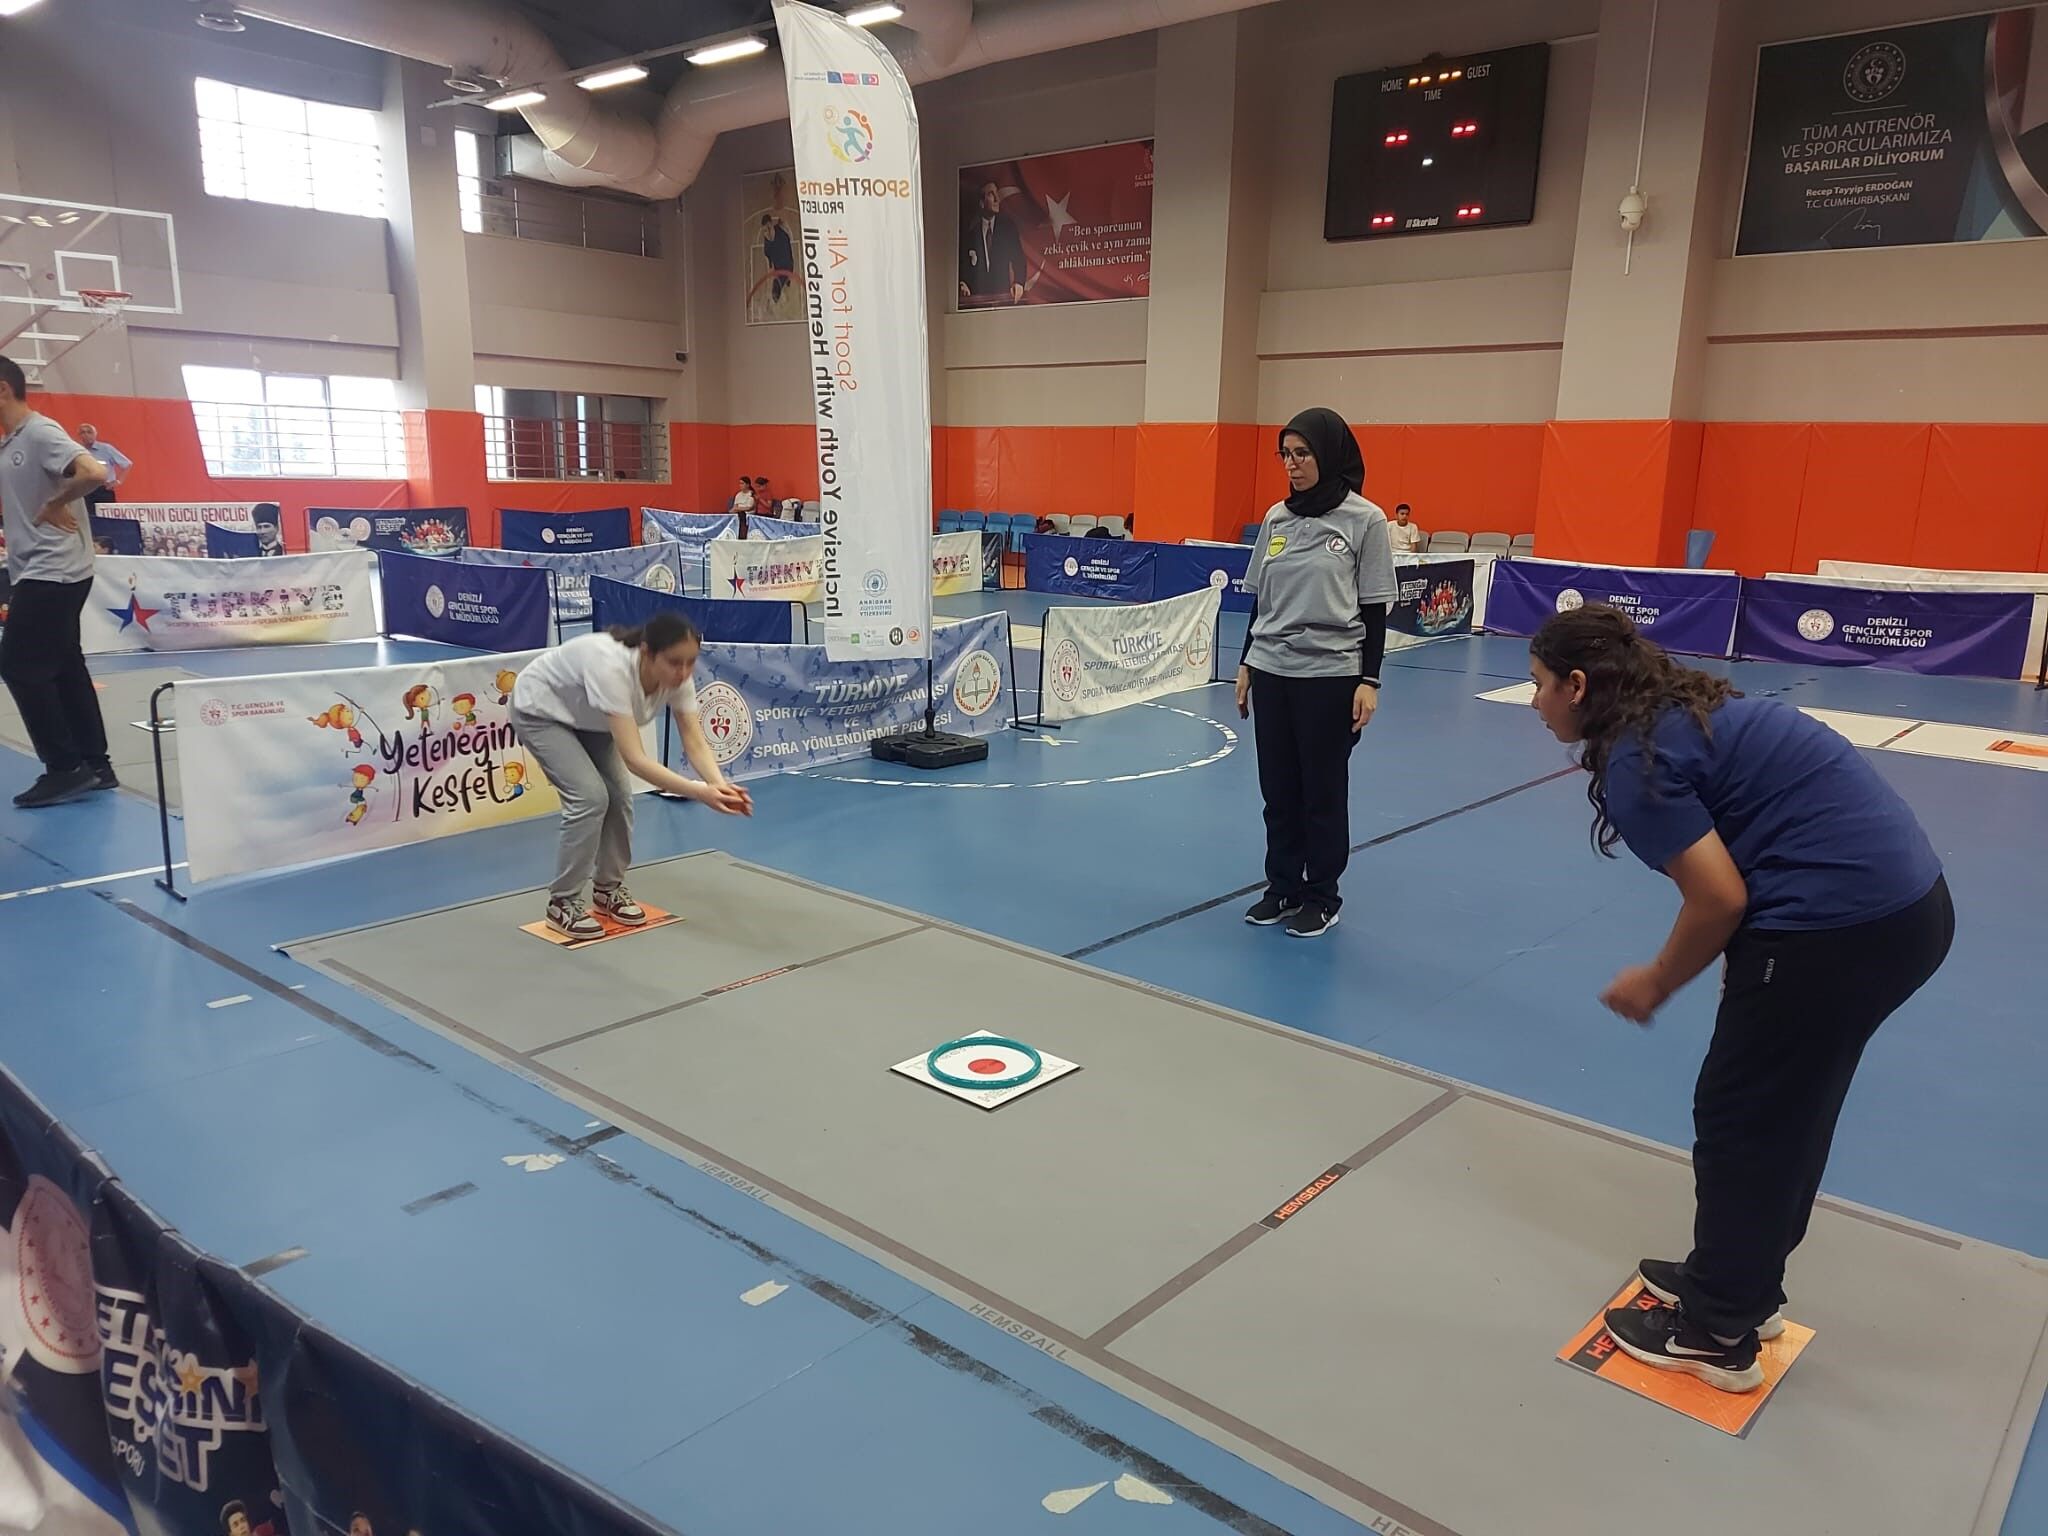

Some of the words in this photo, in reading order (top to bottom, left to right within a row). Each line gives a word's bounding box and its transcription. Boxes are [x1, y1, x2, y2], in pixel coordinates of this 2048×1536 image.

[1381, 79, 1403, 92] HOME
[1466, 64, 1491, 79] GUEST
[1424, 89, 1442, 101] TIME
[1801, 124, 1838, 141] TÜM
[1842, 112, 1936, 137] ANTRENÖR
[1782, 145, 1801, 159] VE
[1804, 129, 1953, 157] SPORCULARIMIZA
[1785, 155, 1860, 174] BAŞARILAR
[1863, 149, 1944, 167] DİLİYORUM
[1806, 187, 1832, 198] Recep
[1834, 185, 1864, 196] Tayyip
[1865, 180, 1913, 192] ERDOĞAN
[1806, 199, 1822, 209] T.C.
[1823, 192, 1911, 208] CUMHURBAŞKANI
[1093, 220, 1142, 237] sporcunun
[1066, 240, 1089, 255] çevik
[1091, 241, 1101, 250] ve
[1103, 238, 1124, 252] aynı
[1125, 237, 1151, 247] zama
[1058, 255, 1105, 269] ahlâklısını
[163, 584, 345, 619] TÜRKİYE
[1608, 594, 1641, 606] DENİZLİ
[1624, 606, 1636, 614] VE
[1636, 607, 1660, 617] SPOR
[1842, 624, 1887, 636] GENÇLİK
[1888, 627, 1902, 637] VE
[1903, 628, 1933, 638] SPOR
[1867, 616, 1908, 627] DENİZLİ
[1112, 632, 1163, 656] TÜRKİYE
[1845, 634, 1855, 643] İL
[1856, 635, 1926, 648] MÜDÜRLÜĞÜ
[1083, 660, 1120, 671] SPORTİF
[814, 674, 908, 704] TÜRKİYE
[755, 706, 817, 722] SPORTİF
[818, 702, 880, 716] YETENEK
[881, 683, 949, 706] TARAMSI
[843, 716, 861, 728] VE
[752, 741, 800, 759] SPORA
[802, 724, 899, 752] YÖNLENDİRME
[900, 710, 952, 735] PROESİ
[379, 722, 523, 774] Yeteneğin
[412, 760, 507, 818] Keşfet
[698, 1161, 770, 1200] HEMSBALL
[1274, 1173, 1340, 1220] HEMSBALL
[968, 1303, 1068, 1361] HEMSBALL
